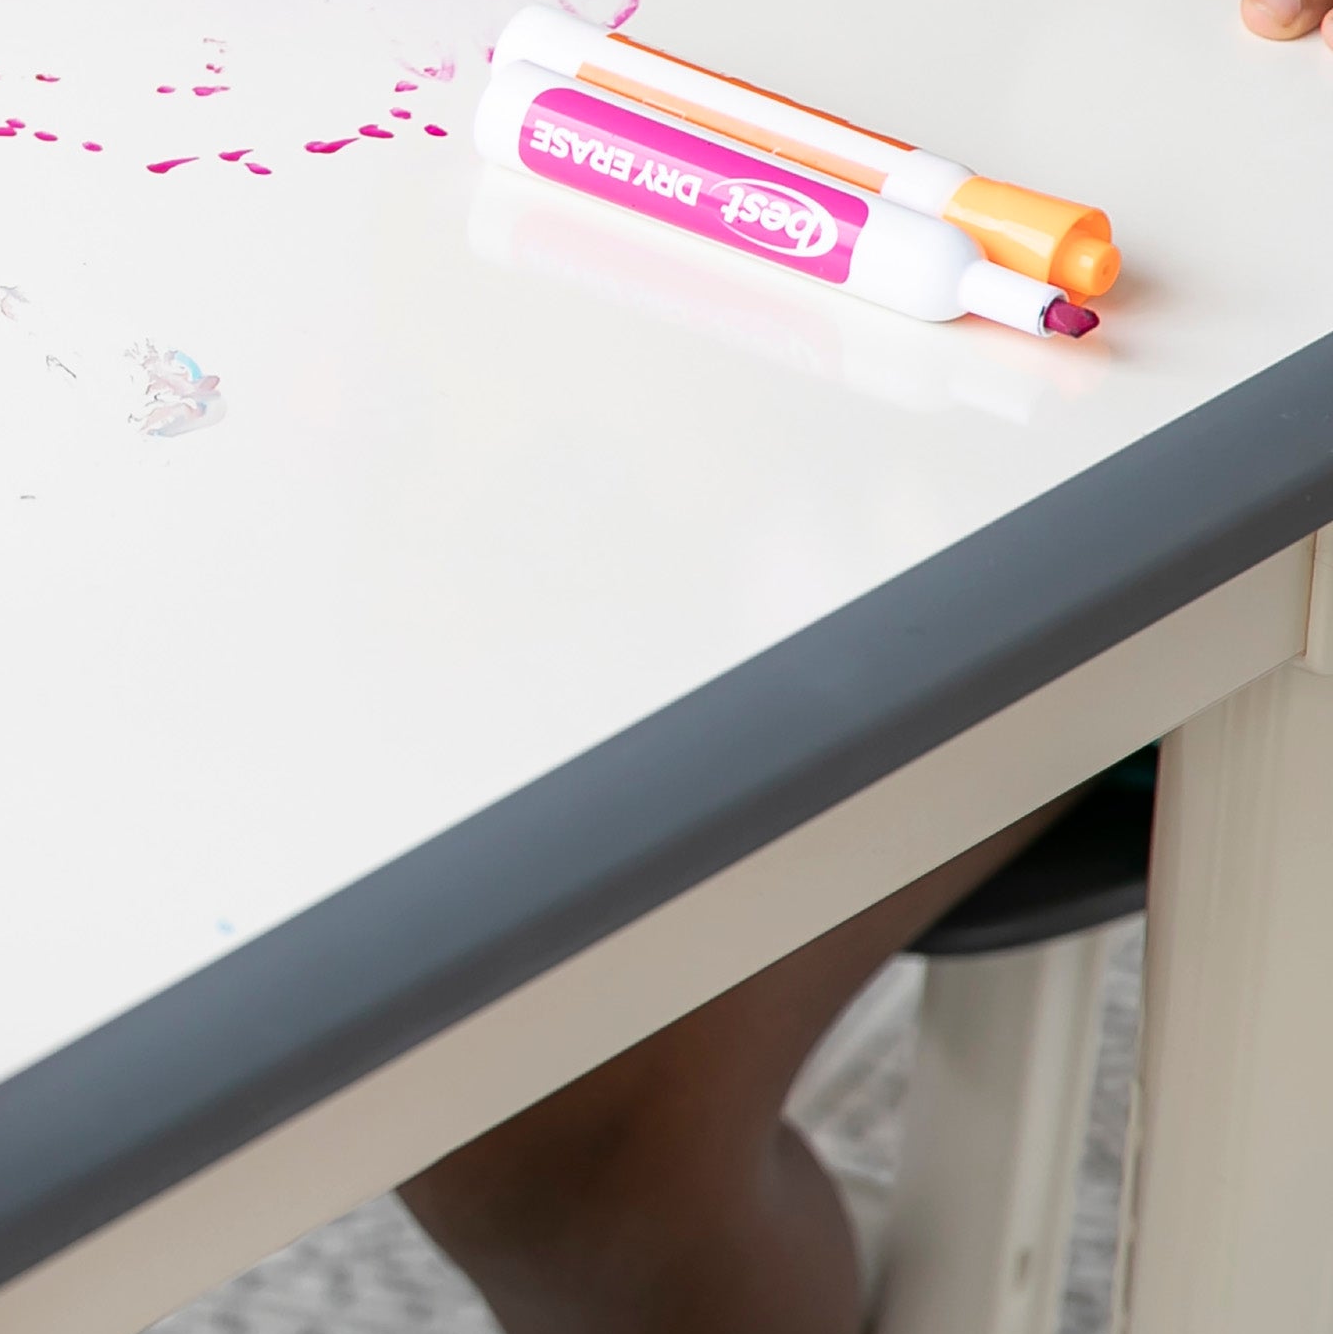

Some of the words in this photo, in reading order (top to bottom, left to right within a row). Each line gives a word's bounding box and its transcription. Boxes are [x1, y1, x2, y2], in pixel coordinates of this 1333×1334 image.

[530, 118, 634, 182] ERASE
[633, 160, 703, 207] DRY
[720, 184, 821, 252] best
